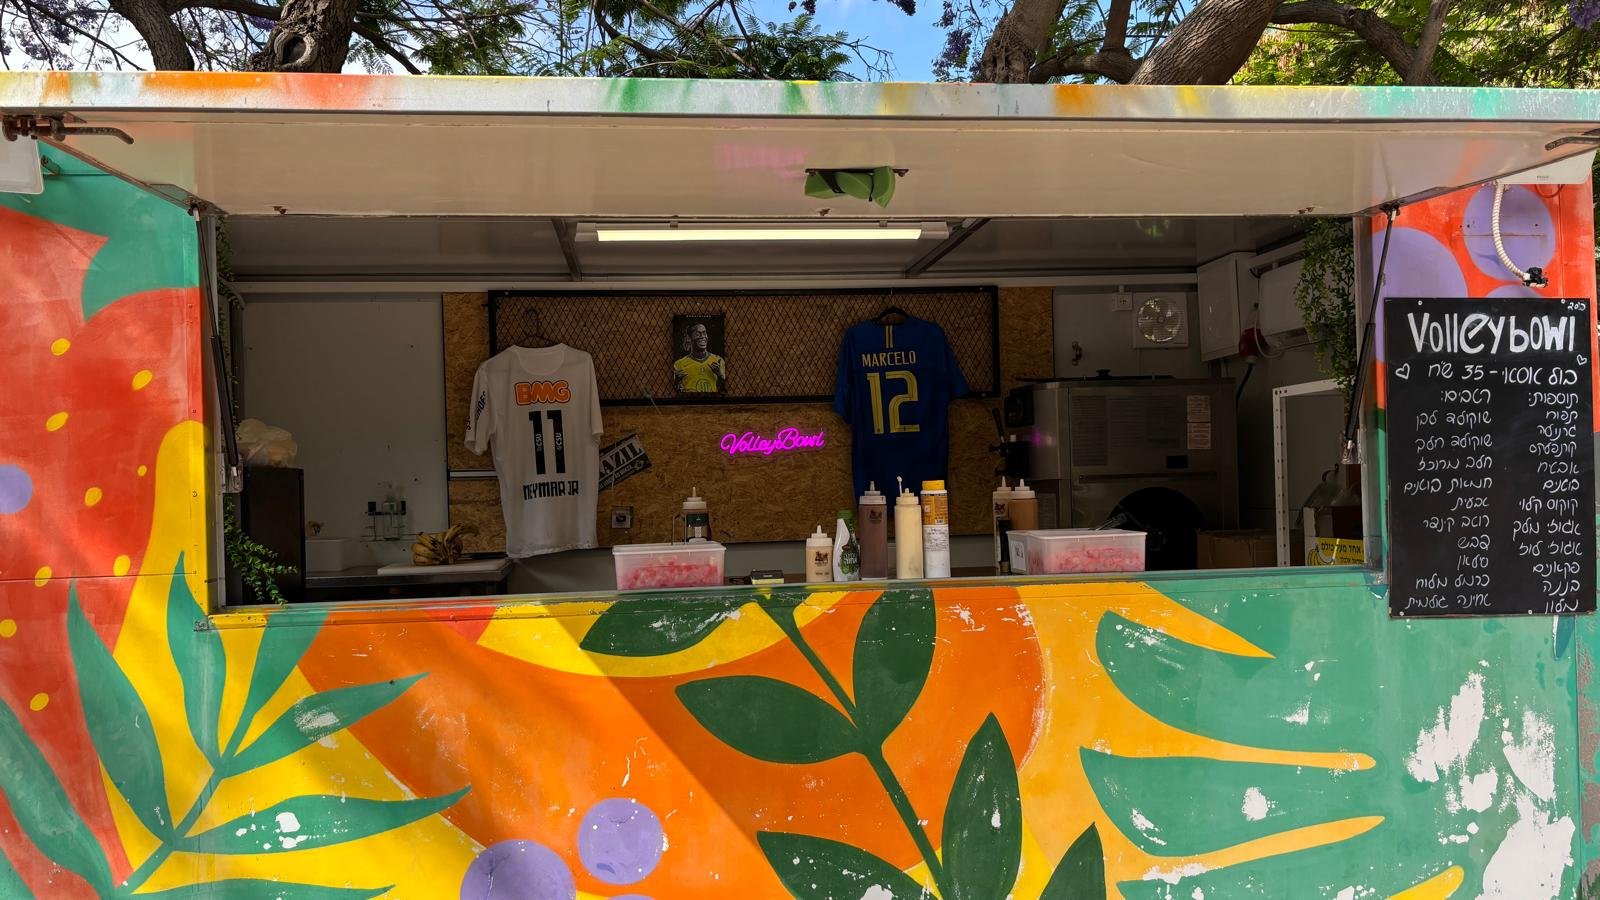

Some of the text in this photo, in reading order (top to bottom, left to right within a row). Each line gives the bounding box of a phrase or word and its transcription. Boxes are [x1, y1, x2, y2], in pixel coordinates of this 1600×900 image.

[861, 350, 916, 368] MARCELO
[1461, 364, 1484, 380] 35
[1548, 367, 1578, 385] בול
[514, 380, 572, 406] BMG
[1440, 388, 1491, 404] רטבים:
[1528, 392, 1579, 409] תוספות:
[866, 370, 920, 435] 12
[1416, 409, 1492, 432] שוקולד לבן
[1546, 410, 1579, 425] תפוח
[528, 410, 566, 475] 11
[1414, 432, 1493, 454] שוקולד חלב
[599, 442, 642, 477] AZIL
[1417, 454, 1493, 471] חלב מרוכז
[1536, 461, 1580, 474] אבטיח
[523, 480, 579, 501] NEYMAR JR
[1403, 477, 1493, 496] חמאת בוטנים
[1542, 478, 1580, 494] בוטנים
[1518, 496, 1578, 516] קוקוס קלוי
[1461, 514, 1490, 528] רוטב
[1512, 516, 1581, 541] אגוזי מלך
[1457, 534, 1491, 551] דבש
[1519, 540, 1582, 556] אגוזי לוז
[1532, 560, 1581, 580] פקאנים
[1416, 572, 1490, 590] כרמל מלוח
[1542, 579, 1580, 596] בננה
[1404, 593, 1492, 610] טחינה גולמית
[1544, 598, 1579, 614] מלון
